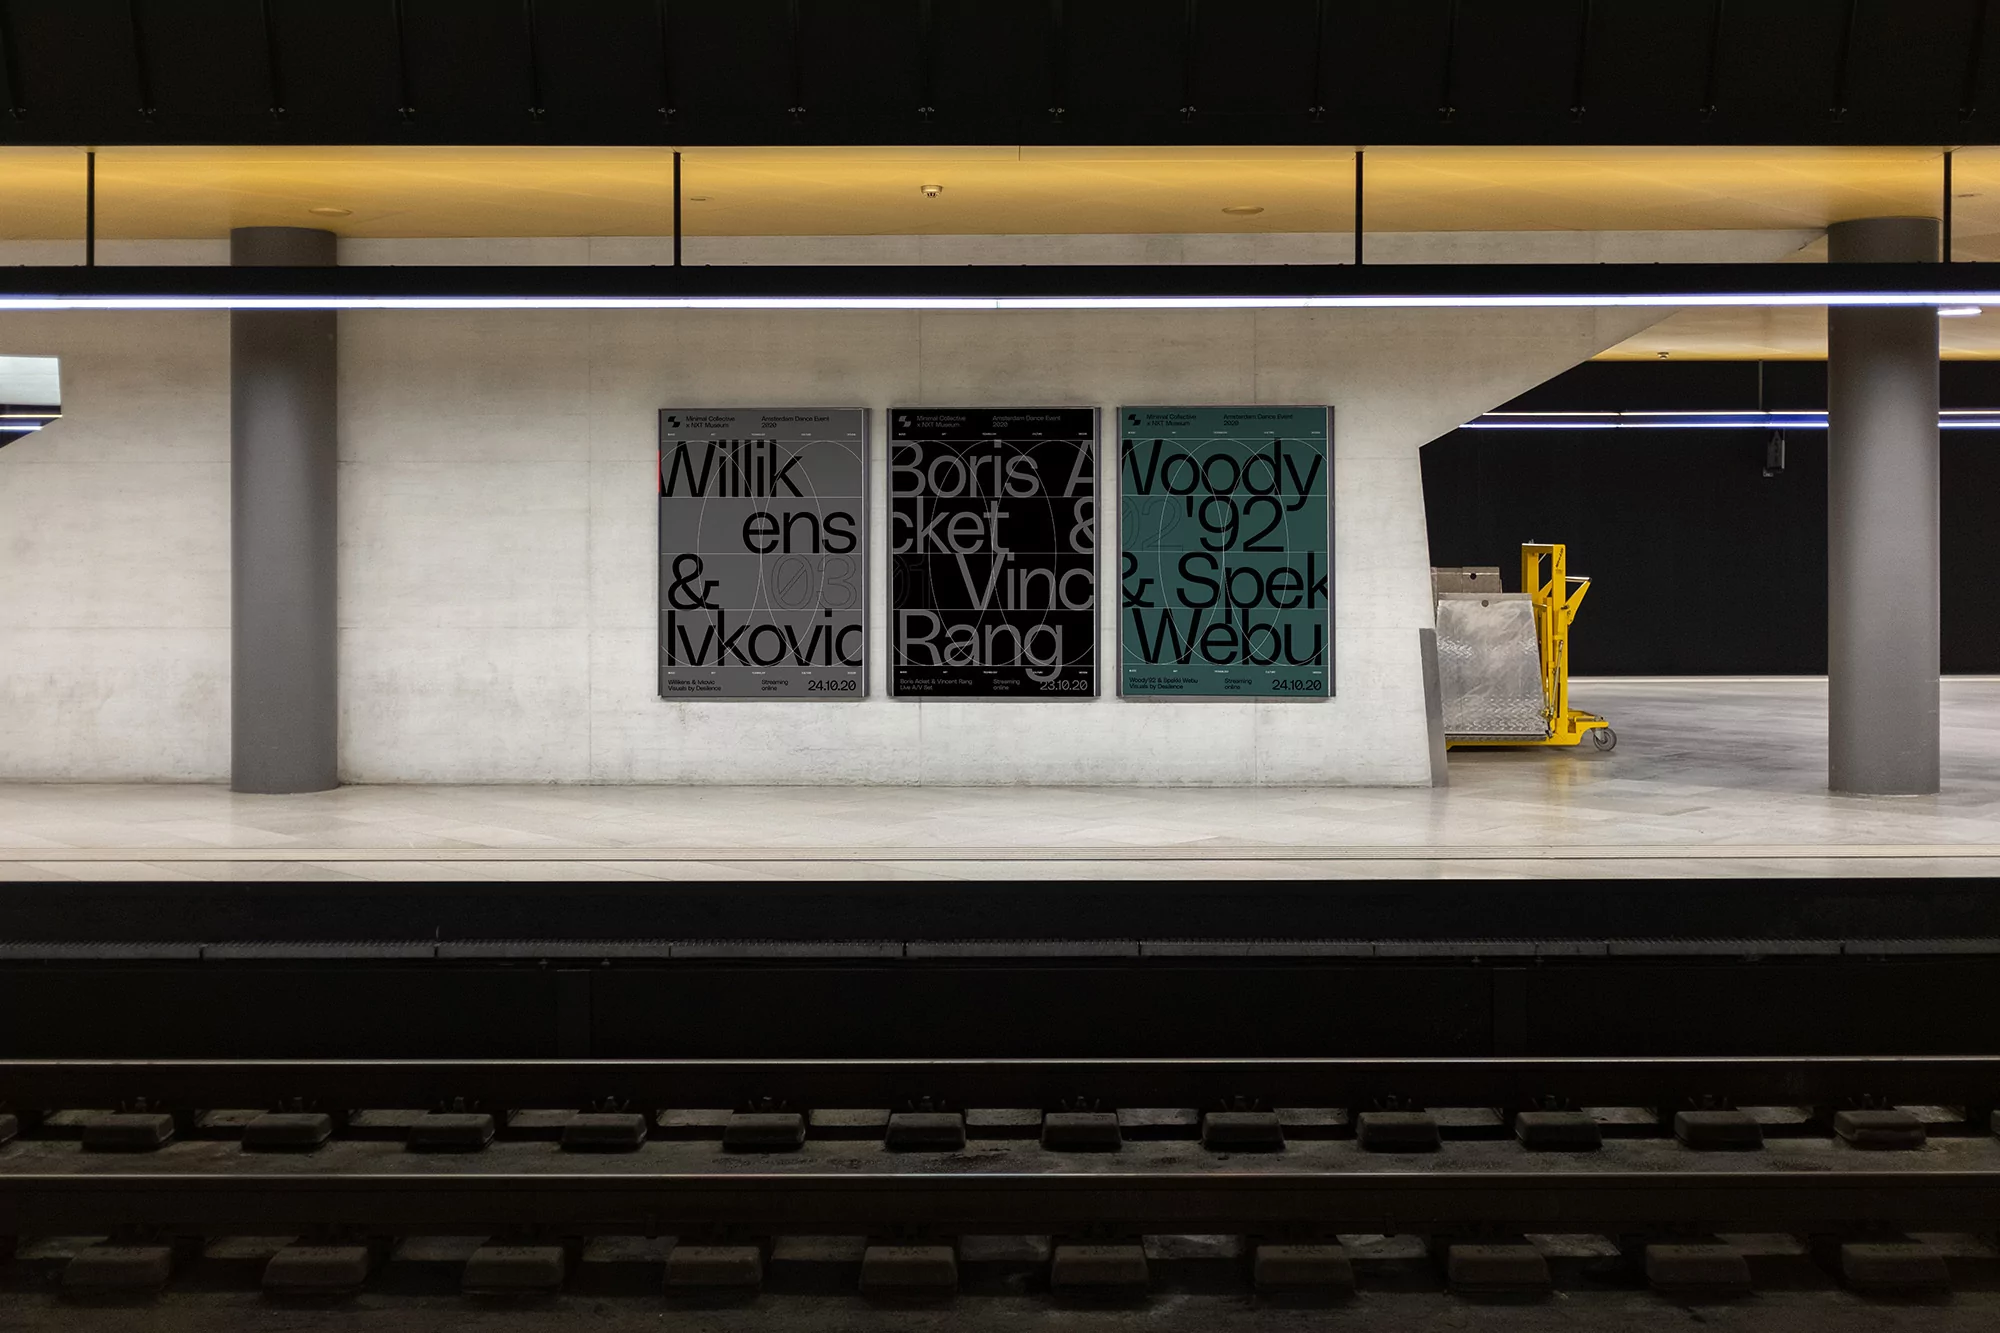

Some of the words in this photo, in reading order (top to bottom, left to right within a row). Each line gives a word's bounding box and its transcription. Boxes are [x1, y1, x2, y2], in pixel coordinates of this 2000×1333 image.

[661, 439, 804, 497] Willik
[892, 439, 1040, 498] Boris
[1122, 438, 1322, 512] Woody
[743, 511, 857, 554] ens
[892, 496, 1010, 555] cket
[1186, 496, 1284, 552] '92
[668, 553, 720, 610] &
[956, 553, 1094, 611] Vinc
[1176, 551, 1328, 625] Spek
[899, 609, 1063, 682] Rang
[1132, 607, 1322, 666] Webu
[808, 680, 856, 691] 24.10.20
[1040, 680, 1088, 691] 23.10.20
[1272, 679, 1322, 691] 24.10.20
